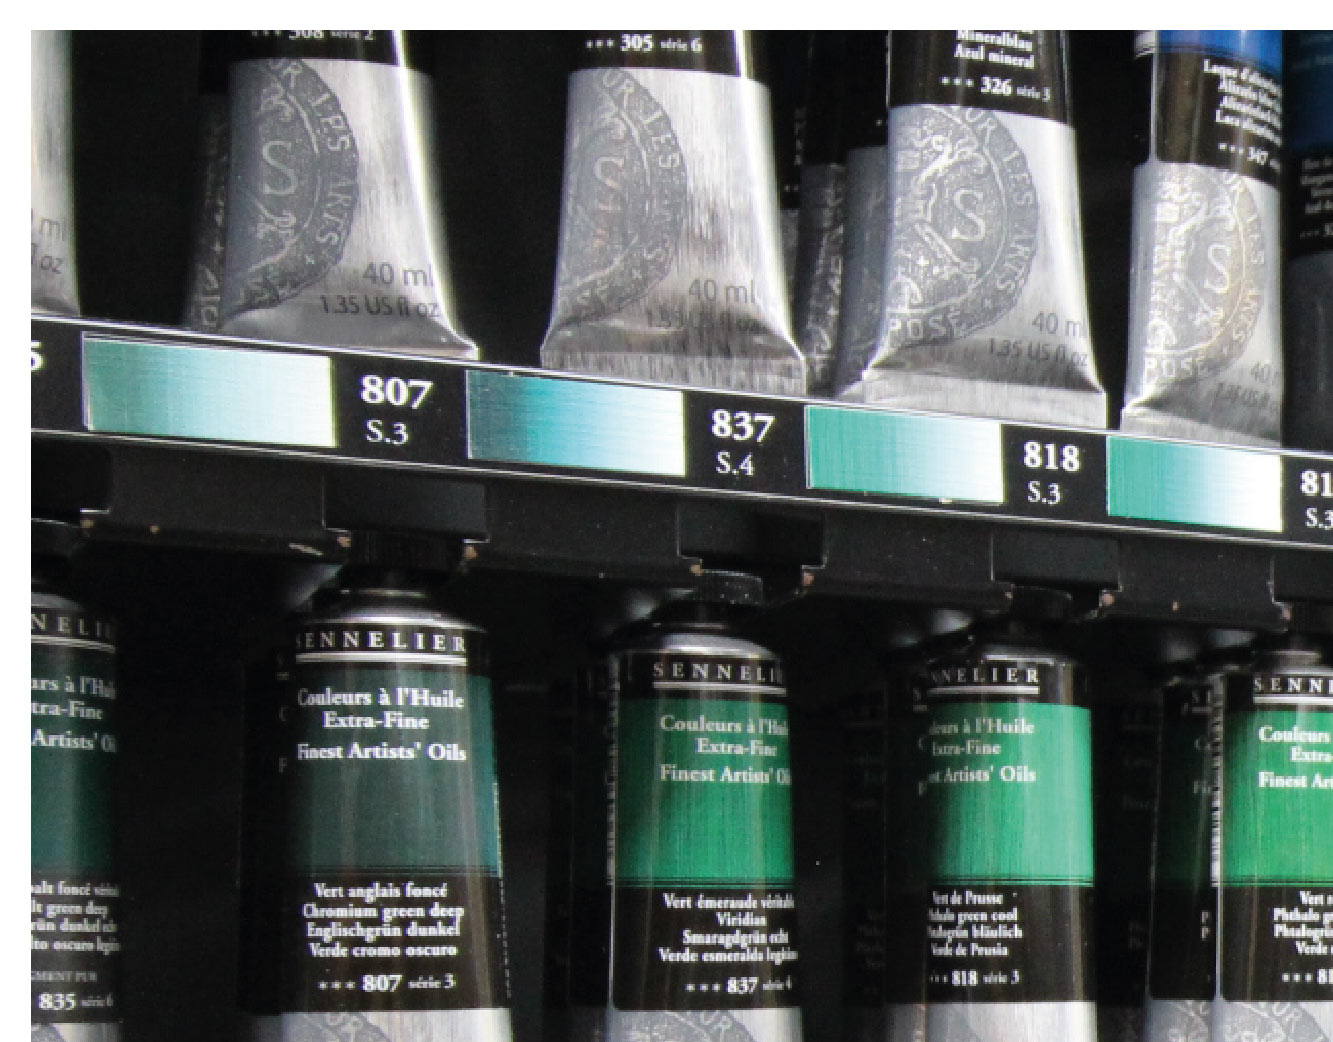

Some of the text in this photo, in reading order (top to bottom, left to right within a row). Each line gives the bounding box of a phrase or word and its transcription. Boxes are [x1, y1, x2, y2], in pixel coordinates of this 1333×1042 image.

[620, 35, 703, 53] 305 6
[954, 43, 985, 60] Azul
[981, 76, 1013, 95] 326
[363, 264, 433, 288] 40 ml
[688, 279, 755, 304] 40 ml
[365, 295, 393, 316] US
[1032, 311, 1060, 334] 40
[361, 374, 432, 409] 807
[366, 420, 409, 445] S.3
[712, 409, 775, 442] 837
[717, 451, 755, 476] S.4
[1023, 441, 1080, 472] 818
[1028, 482, 1062, 505] S.3
[298, 688, 464, 708] Couleurs à l'Huile
[323, 711, 429, 729] Extra-Fine
[660, 715, 741, 732] Couleurs
[975, 718, 1035, 733] l'Huile
[1259, 726, 1330, 743] Couleurs
[298, 741, 466, 761] Finest Artists' Oils
[696, 738, 777, 756] Extra-Fine
[660, 764, 714, 781] Finest
[1000, 766, 1036, 782] Oils
[1259, 770, 1307, 787] Finest
[314, 882, 344, 898] Vert
[347, 882, 400, 903] anglais
[303, 902, 464, 922] Chromium green deep
[991, 907, 1017, 921] cool
[307, 920, 460, 942] Englischgrün dunkel
[309, 942, 458, 957] Verde cromo oscuro
[362, 973, 456, 992] 807 3
[727, 977, 759, 994] 837
[952, 970, 977, 986] 818
[39, 993, 76, 1009] 835
